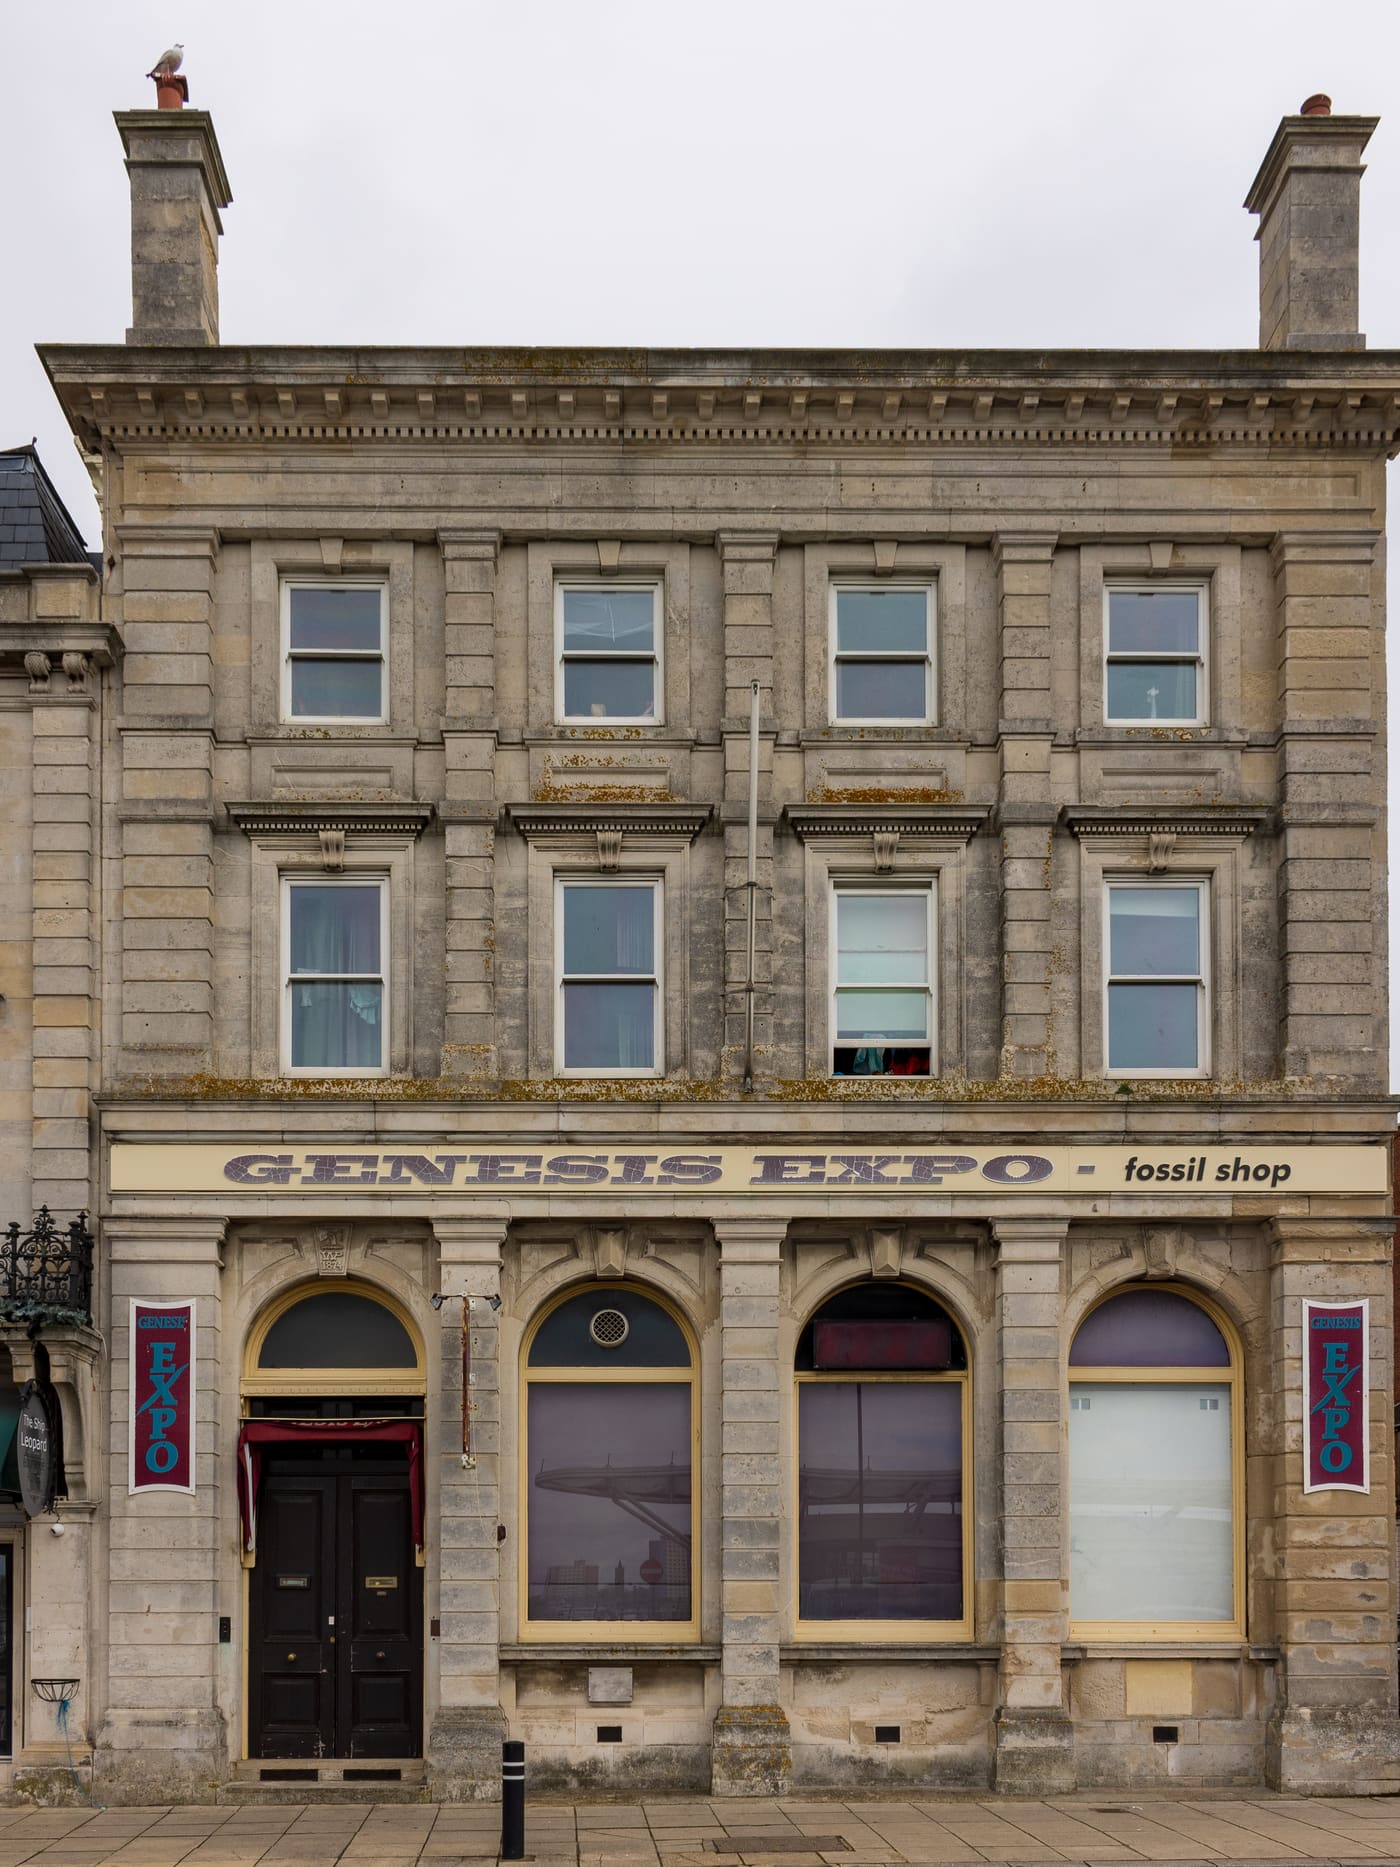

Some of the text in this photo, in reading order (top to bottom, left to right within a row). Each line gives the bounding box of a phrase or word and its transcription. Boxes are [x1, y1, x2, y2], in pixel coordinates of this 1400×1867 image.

[223, 1154, 723, 1185] GENESIS
[750, 1155, 1054, 1184] EXPO
[1124, 1156, 1206, 1182] fossil
[1215, 1156, 1292, 1188] shop
[1311, 1316, 1361, 1329] GENESIS
[137, 1342, 189, 1473] EXPO
[1311, 1342, 1361, 1473] EXPO
[23, 1414, 46, 1432] The Ship
[21, 1431, 47, 1452] Leopard
